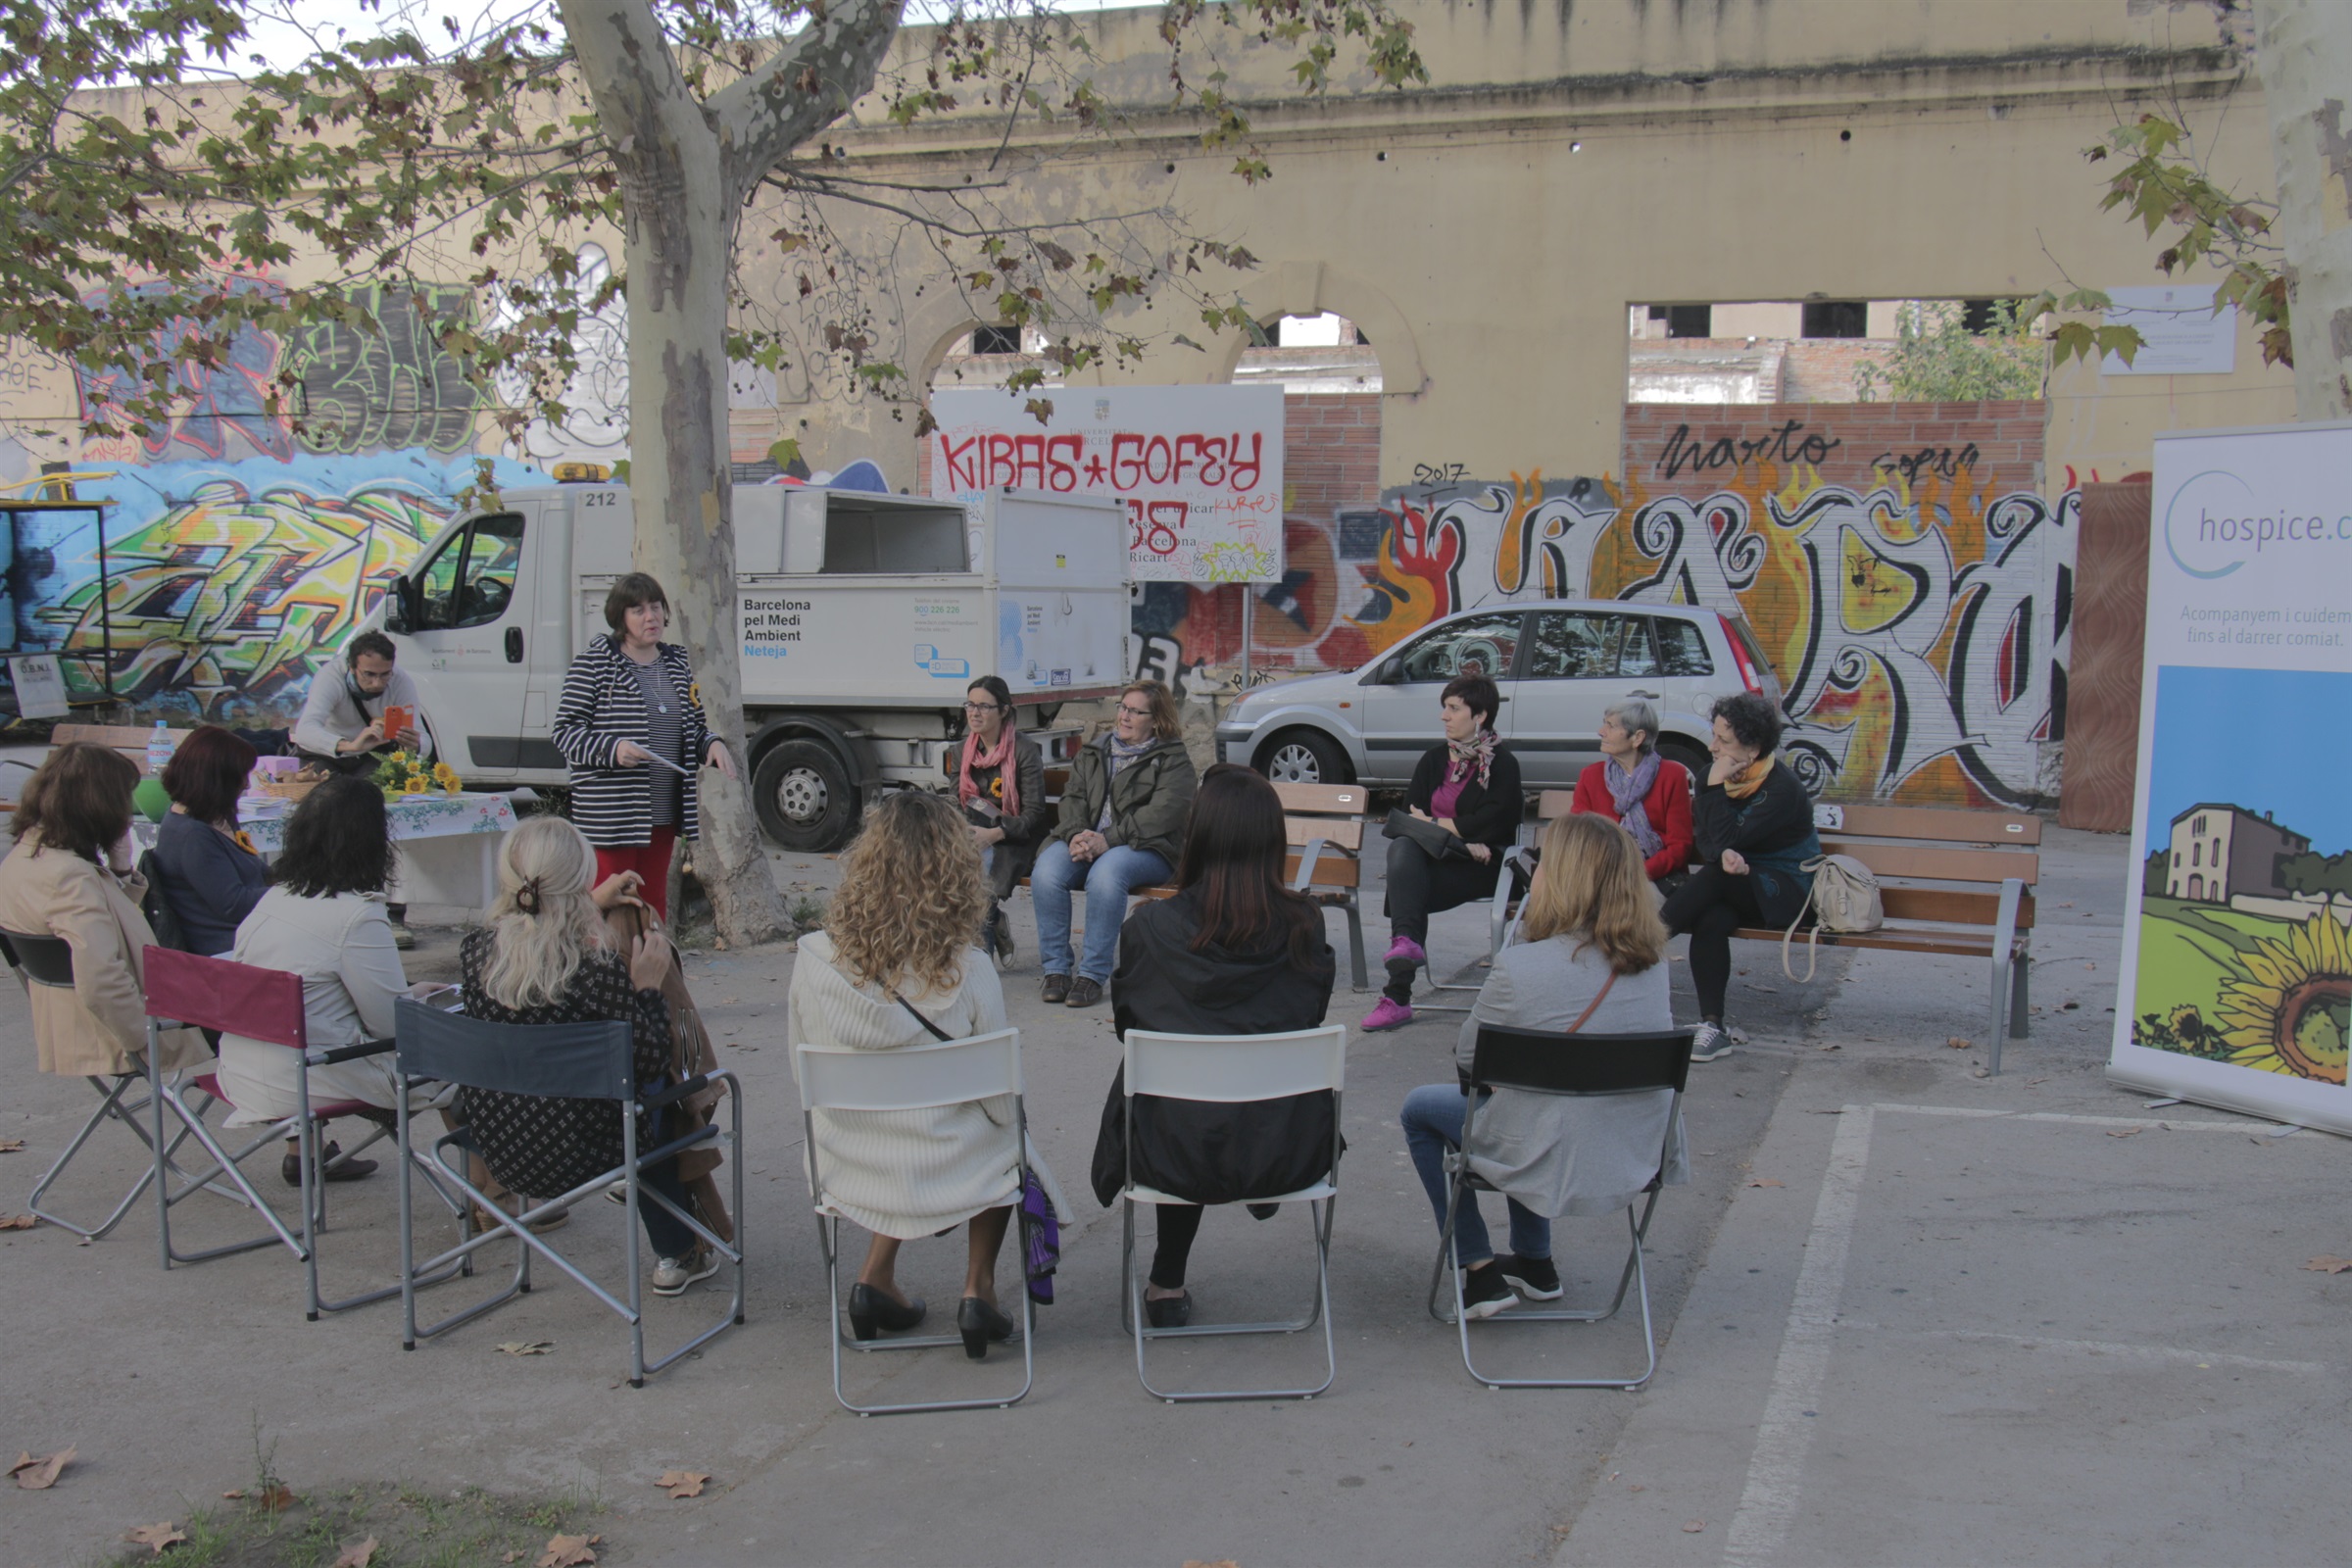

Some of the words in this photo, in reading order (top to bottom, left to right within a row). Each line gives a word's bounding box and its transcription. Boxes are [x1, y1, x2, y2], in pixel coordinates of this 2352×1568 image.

[1414, 463, 1468, 486] 2017
[586, 492, 616, 507] 212
[1173, 502, 1214, 514] uicar
[1129, 518, 1177, 530] Reseva
[1133, 535, 1197, 547] Barcelona
[1129, 552, 1169, 563] Ricart
[744, 599, 810, 611] Barcelona
[745, 614, 763, 628] pel
[768, 614, 801, 625] Medi
[2180, 605, 2280, 626] Acompanyem
[2294, 607, 2352, 623] cuidem
[745, 629, 802, 641] Ambient
[2187, 626, 2214, 643] fins
[2218, 627, 2231, 643] al
[2235, 627, 2282, 645] darrer
[2286, 630, 2344, 647] comiat.
[745, 645, 787, 660] Neteja
